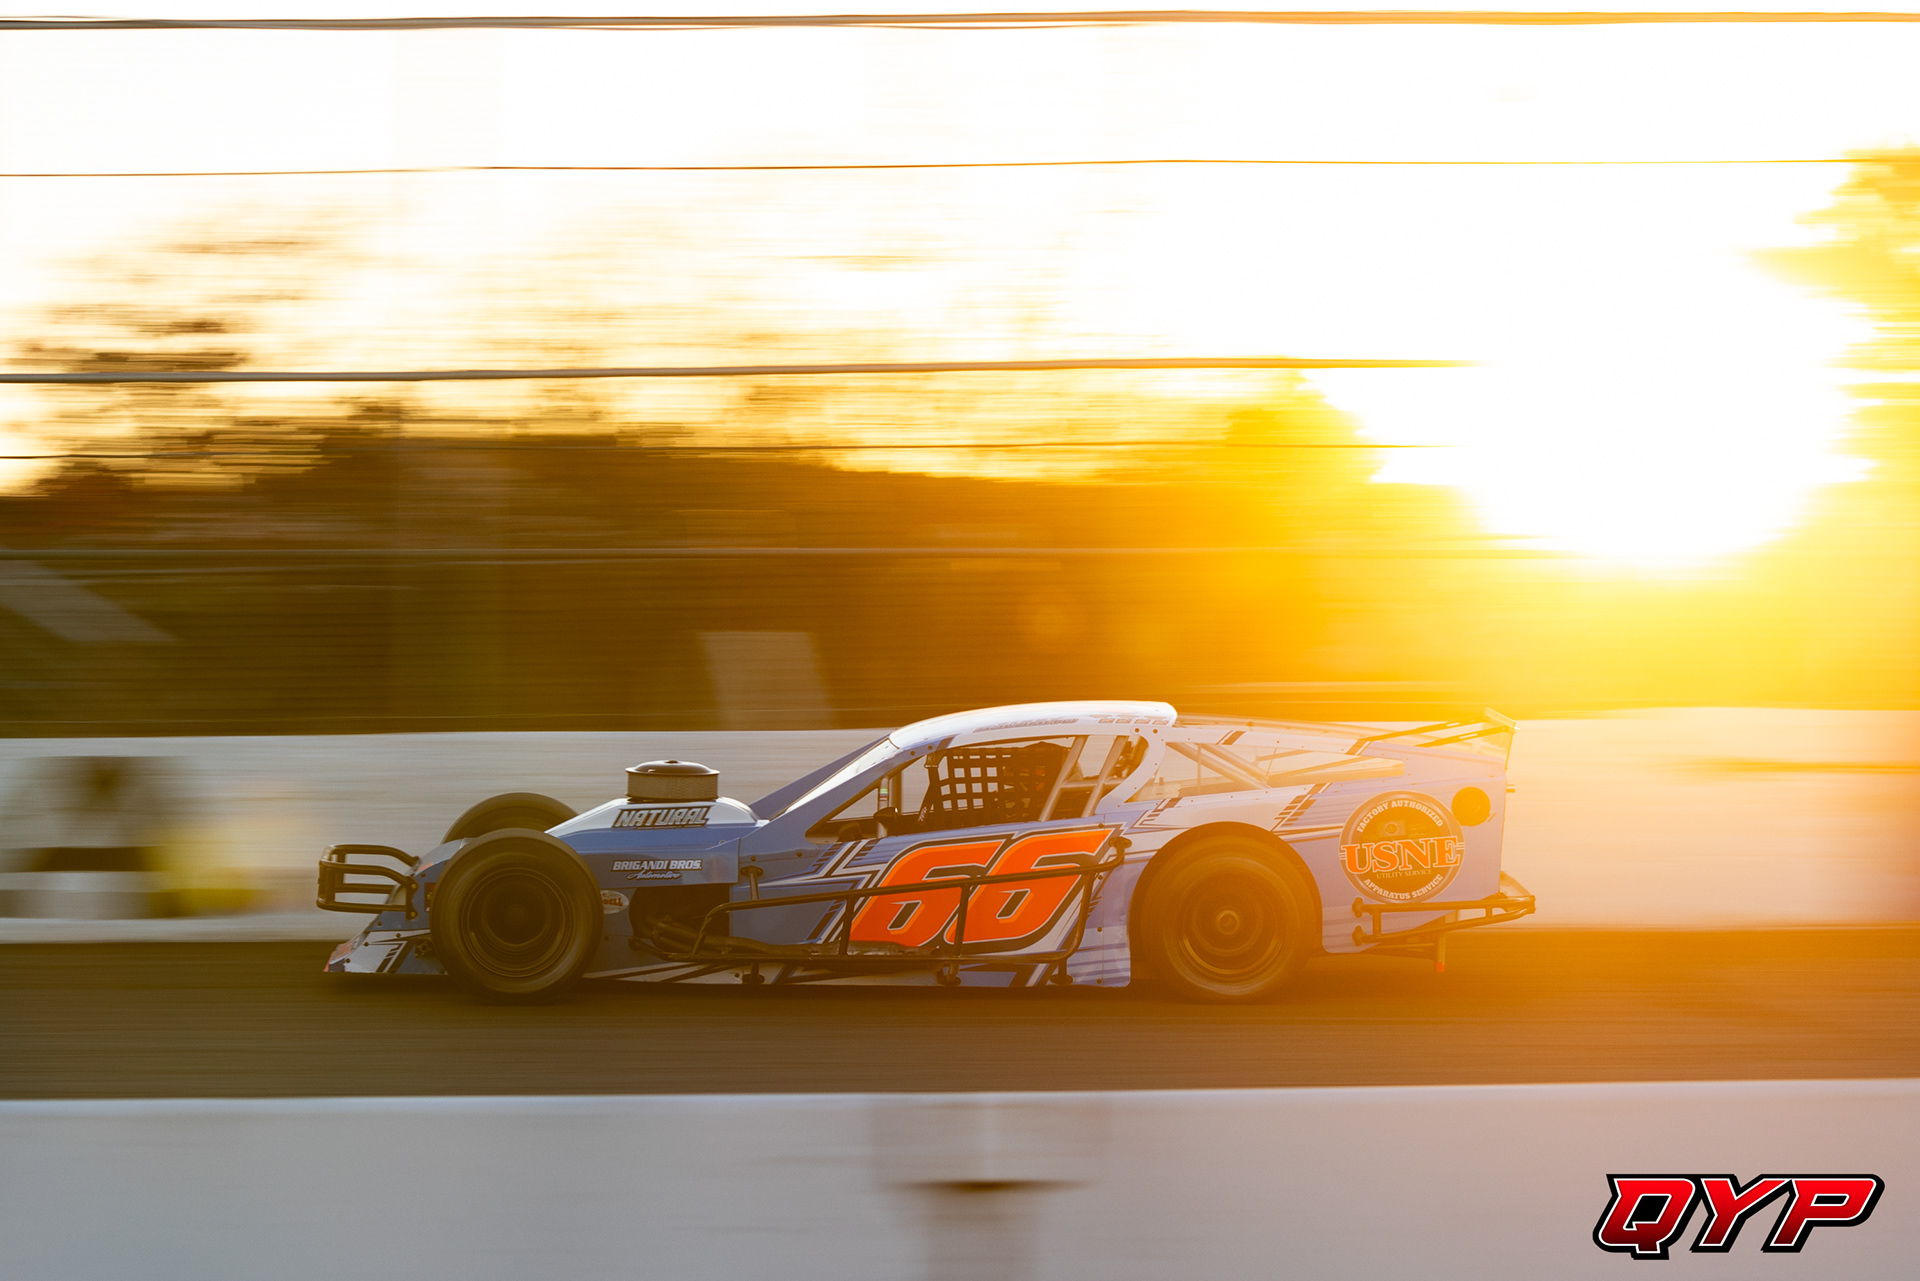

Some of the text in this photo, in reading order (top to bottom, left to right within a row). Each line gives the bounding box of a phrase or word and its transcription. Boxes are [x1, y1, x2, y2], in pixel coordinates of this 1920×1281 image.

[614, 807, 709, 827] NATURAL
[1357, 800, 1443, 833] FACTORY AUTHORIZED
[612, 859, 702, 871] BRIGANDI BROS.
[1341, 836, 1460, 875] USNE
[627, 870, 681, 879] Automotive
[1376, 868, 1433, 879] UTILITY SERVICE
[848, 827, 1115, 948] 66
[1363, 873, 1443, 899] APPARATUS SERVICE
